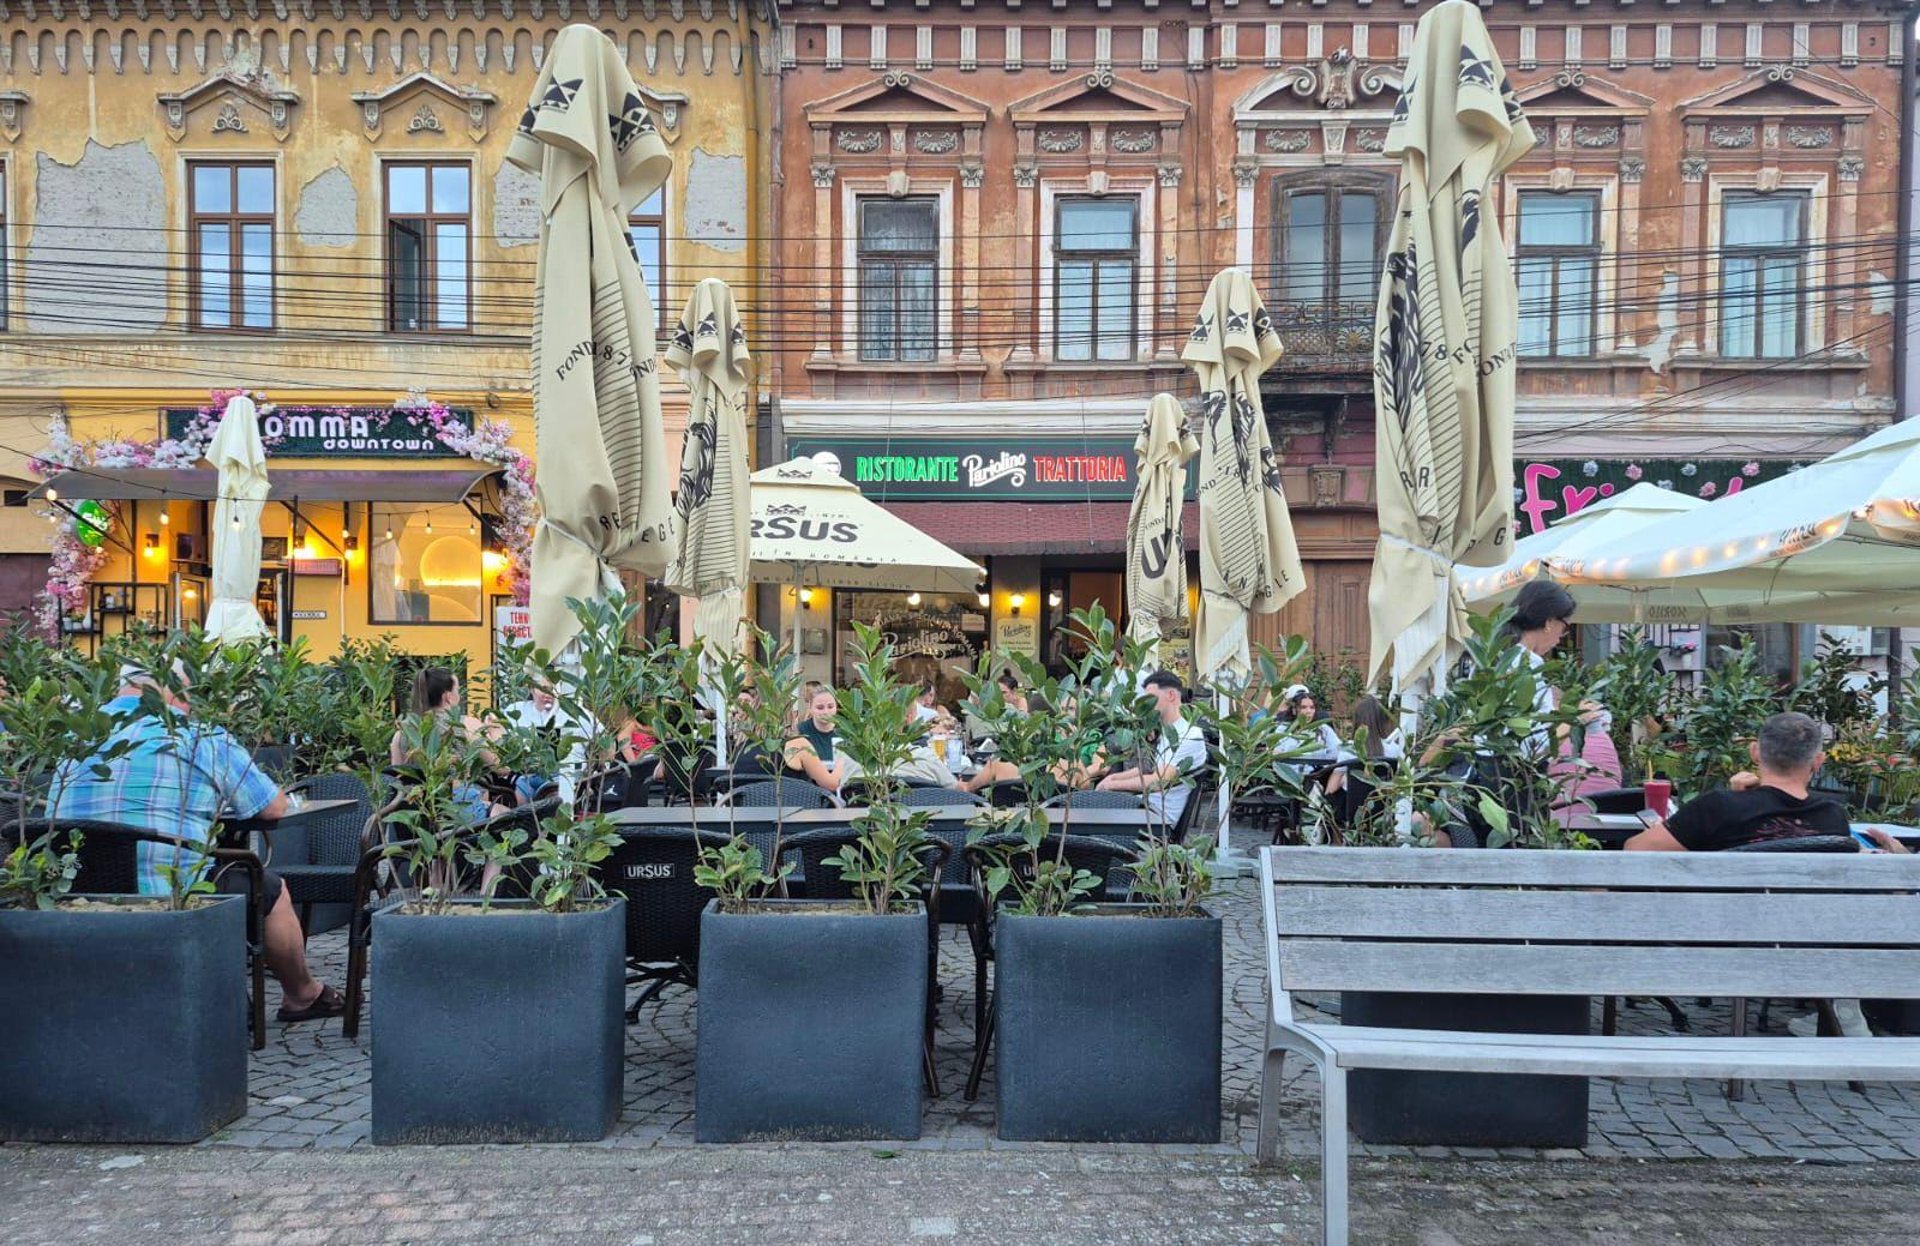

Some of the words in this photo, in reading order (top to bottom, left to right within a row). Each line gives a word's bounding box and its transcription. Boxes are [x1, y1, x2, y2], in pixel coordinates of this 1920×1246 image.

[264, 415, 369, 438] OMMA
[856, 456, 959, 482] RISTORANTE
[962, 451, 1027, 488] Pariolino
[1034, 456, 1127, 482] TRATTORIA
[751, 516, 859, 543] RSUS
[627, 864, 671, 878] URSUS
